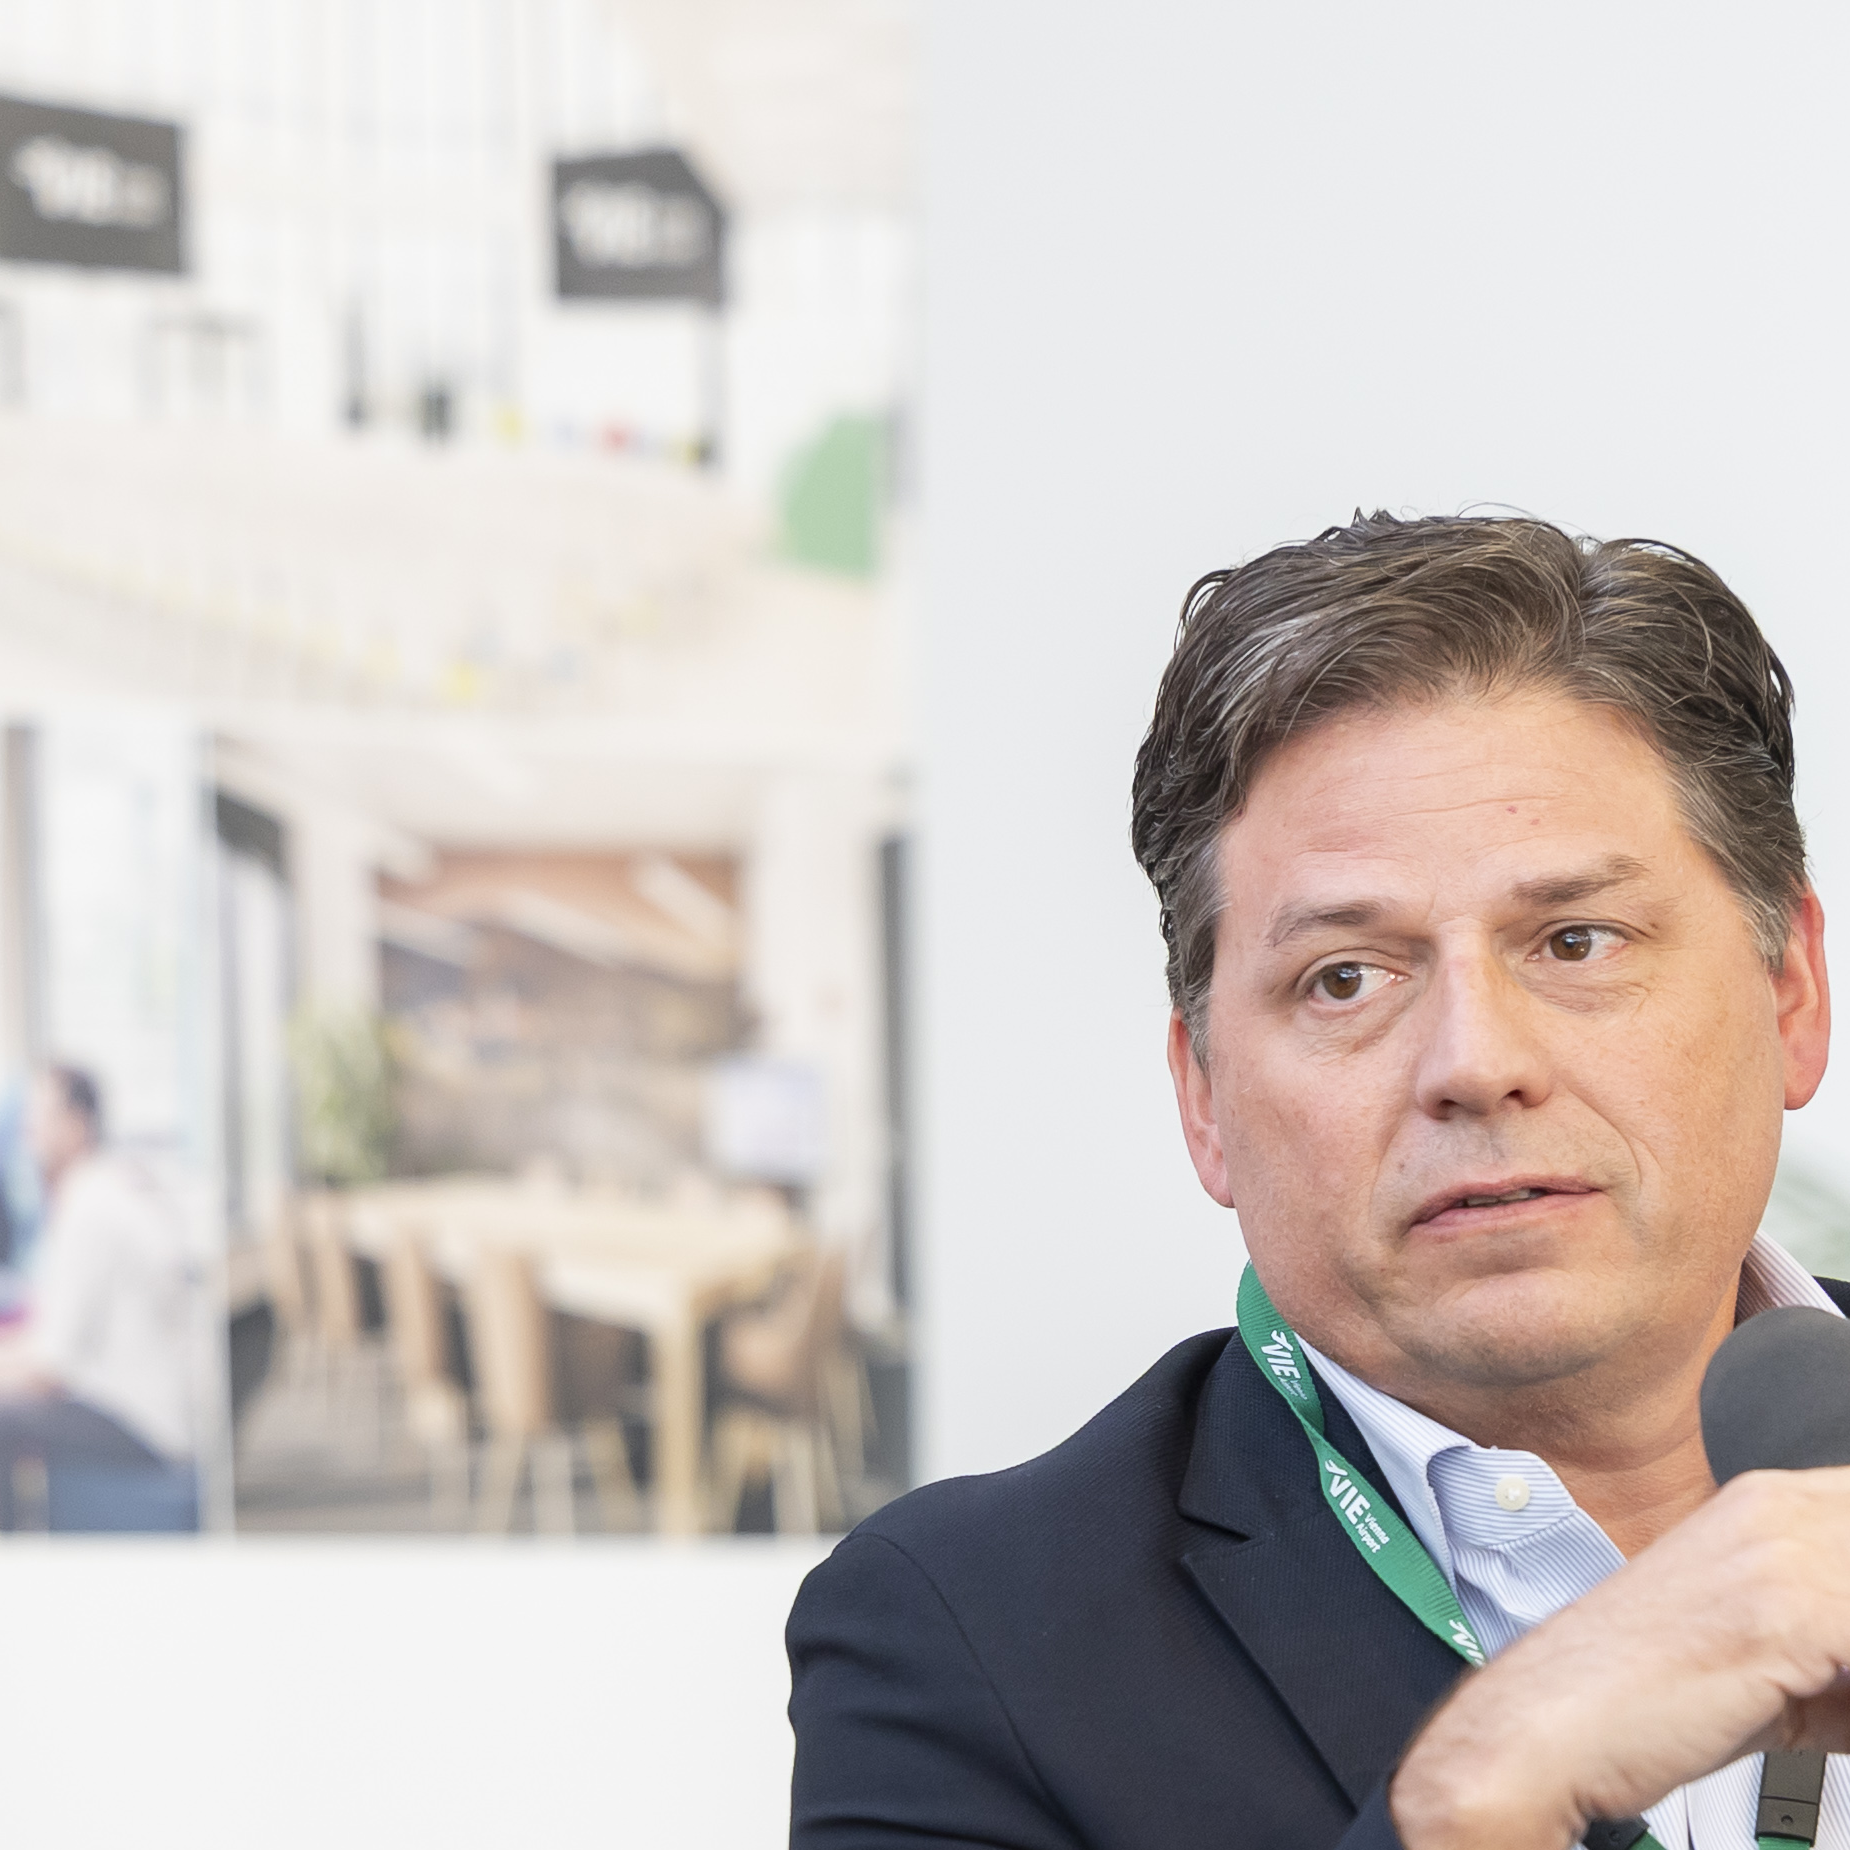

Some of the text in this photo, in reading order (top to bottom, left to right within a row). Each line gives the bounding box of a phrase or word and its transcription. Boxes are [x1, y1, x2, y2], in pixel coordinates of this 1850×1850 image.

[1261, 1344, 1301, 1379] VIE
[1330, 1474, 1371, 1525] VIE
[1355, 1523, 1381, 1553] Airport
[1365, 1513, 1390, 1545] Vienna
